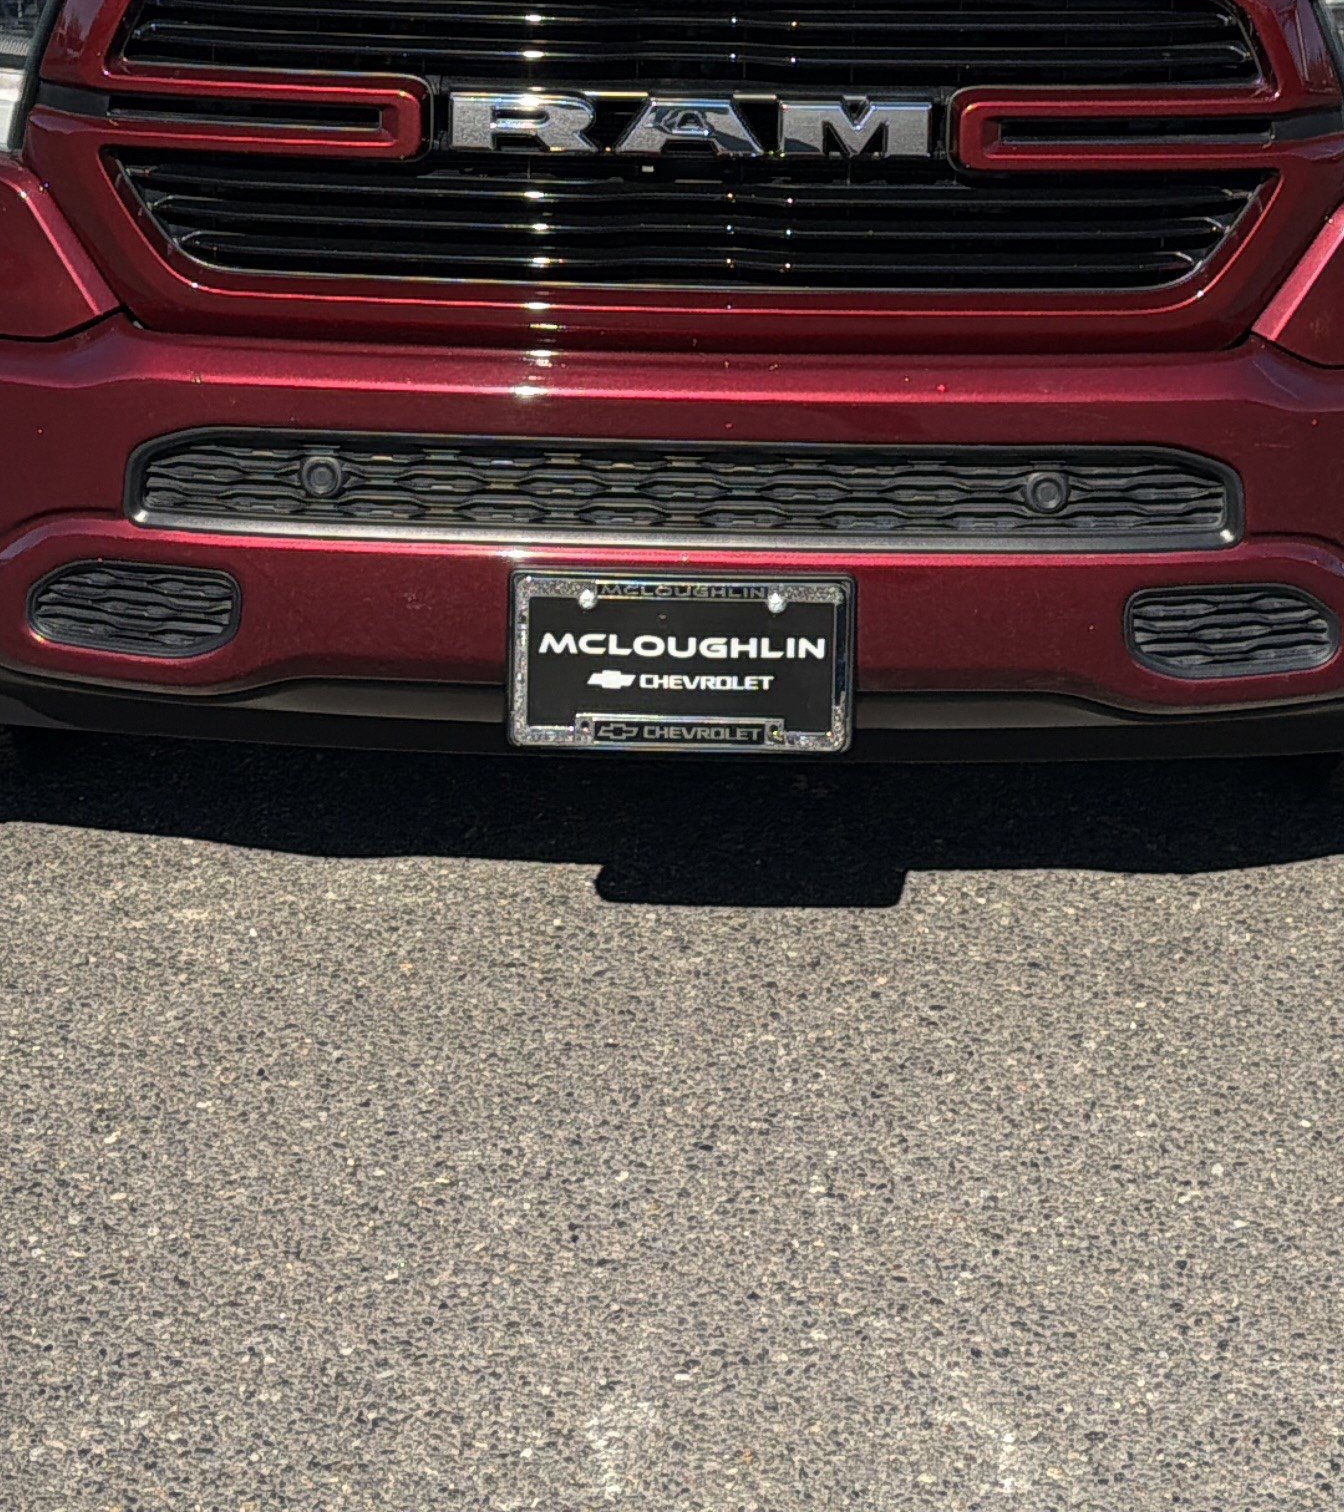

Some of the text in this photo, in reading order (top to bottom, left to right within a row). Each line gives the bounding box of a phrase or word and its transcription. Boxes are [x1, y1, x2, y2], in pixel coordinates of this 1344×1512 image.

[449, 91, 932, 157] RAM
[601, 583, 766, 599] MCLOUGHLIN
[538, 632, 826, 660] MCLOUGHLIN
[639, 674, 775, 691] CHEVROLET
[642, 724, 762, 741] CHEVROLET
